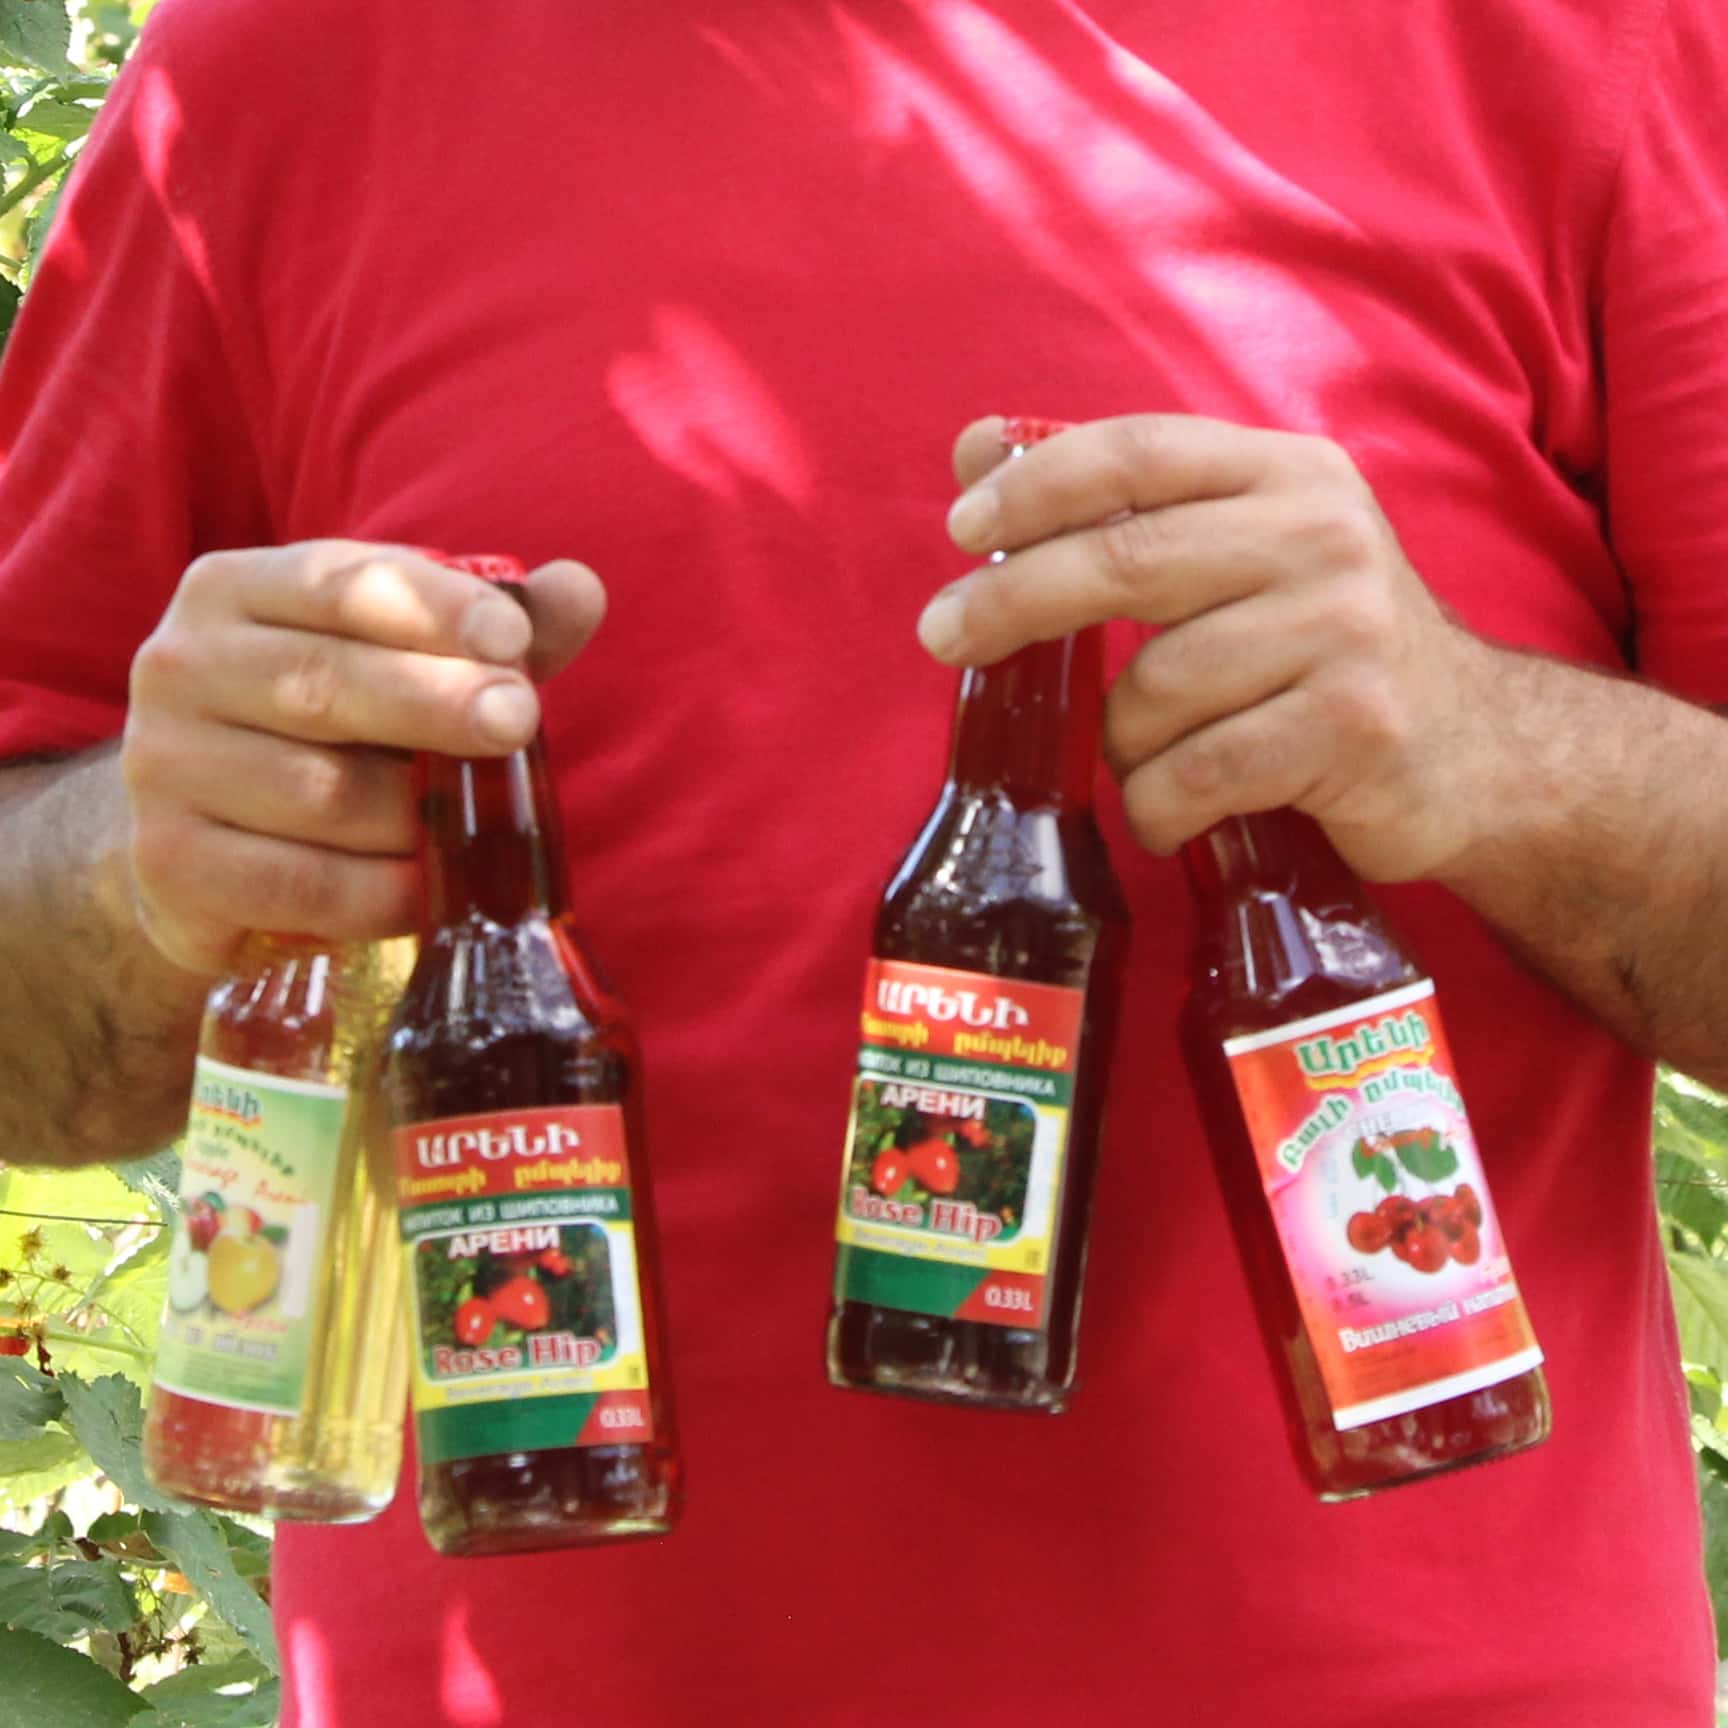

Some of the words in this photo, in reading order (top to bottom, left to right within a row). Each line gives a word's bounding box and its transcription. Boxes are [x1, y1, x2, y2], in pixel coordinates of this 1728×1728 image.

[1296, 1010, 1430, 1073] Արենի
[933, 1062, 1057, 1097] ШИПОВНИКА
[880, 1083, 987, 1120] АРЕНИ
[500, 1193, 619, 1222] ШИПОВНИКА
[929, 1197, 1004, 1243] Hip
[447, 1224, 560, 1260] АРЕНИ
[432, 1345, 521, 1376] Rose
[527, 1331, 602, 1370] Hip
